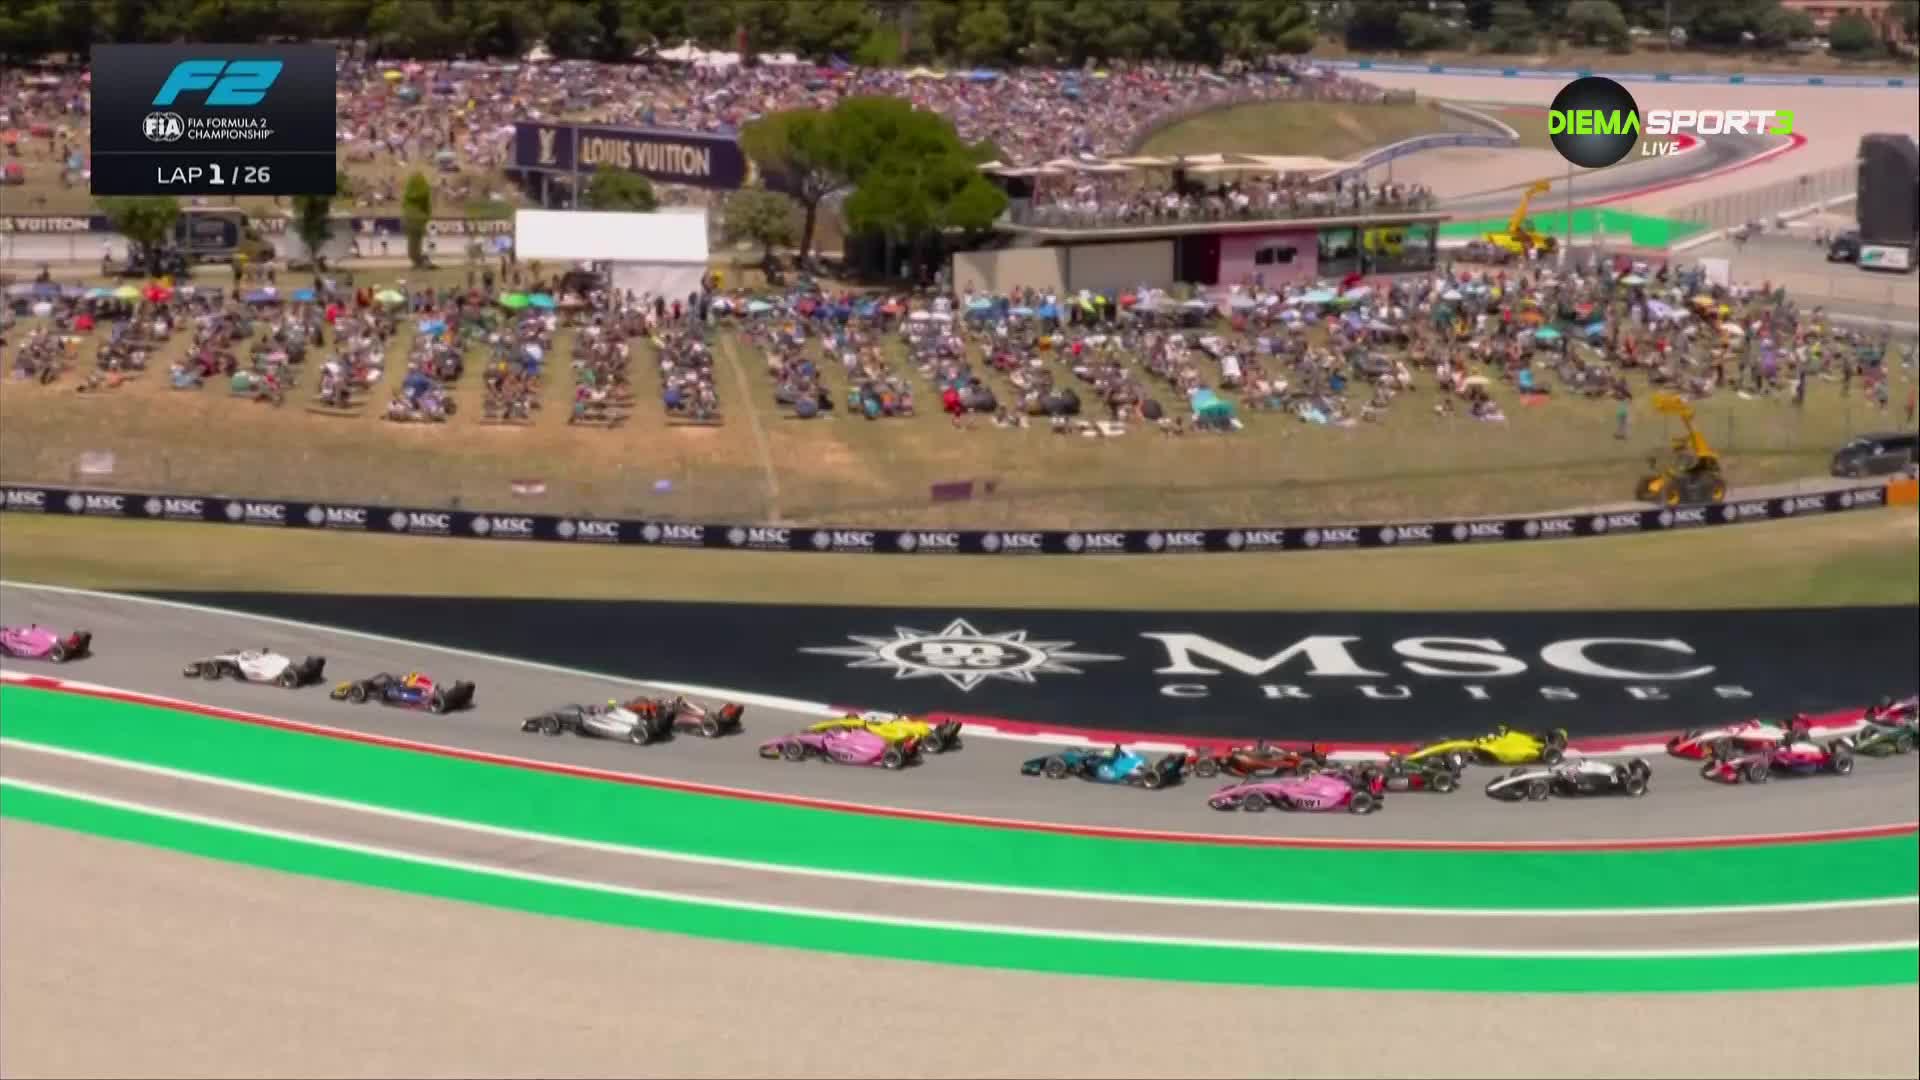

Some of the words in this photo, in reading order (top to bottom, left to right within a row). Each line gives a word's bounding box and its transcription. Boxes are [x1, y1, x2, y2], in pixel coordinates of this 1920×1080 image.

[583, 136, 632, 168] LOUIS
[633, 142, 710, 175] VUITTON
[7, 491, 46, 505] MSC
[85, 495, 124, 510] MSC
[164, 499, 202, 514] MSC
[246, 504, 286, 519] MSC
[326, 508, 366, 522] MSC
[409, 513, 450, 528] MSC
[490, 518, 533, 533] MSC
[576, 522, 620, 536] MSC
[661, 525, 704, 539] MSC
[1398, 526, 1434, 538] MSC
[1469, 523, 1504, 536] MSC
[1541, 520, 1576, 533] MSC
[748, 527, 791, 543] MSC
[831, 532, 874, 546] MSC
[918, 533, 959, 546] MSC
[1001, 533, 1041, 547] MSC
[1085, 533, 1126, 547] MSC
[1165, 533, 1204, 546] MSC
[1245, 531, 1283, 544] MSC
[1321, 529, 1359, 542] MSC
[1140, 632, 1716, 680] MSC
[1159, 684, 1753, 699] CRUISES
